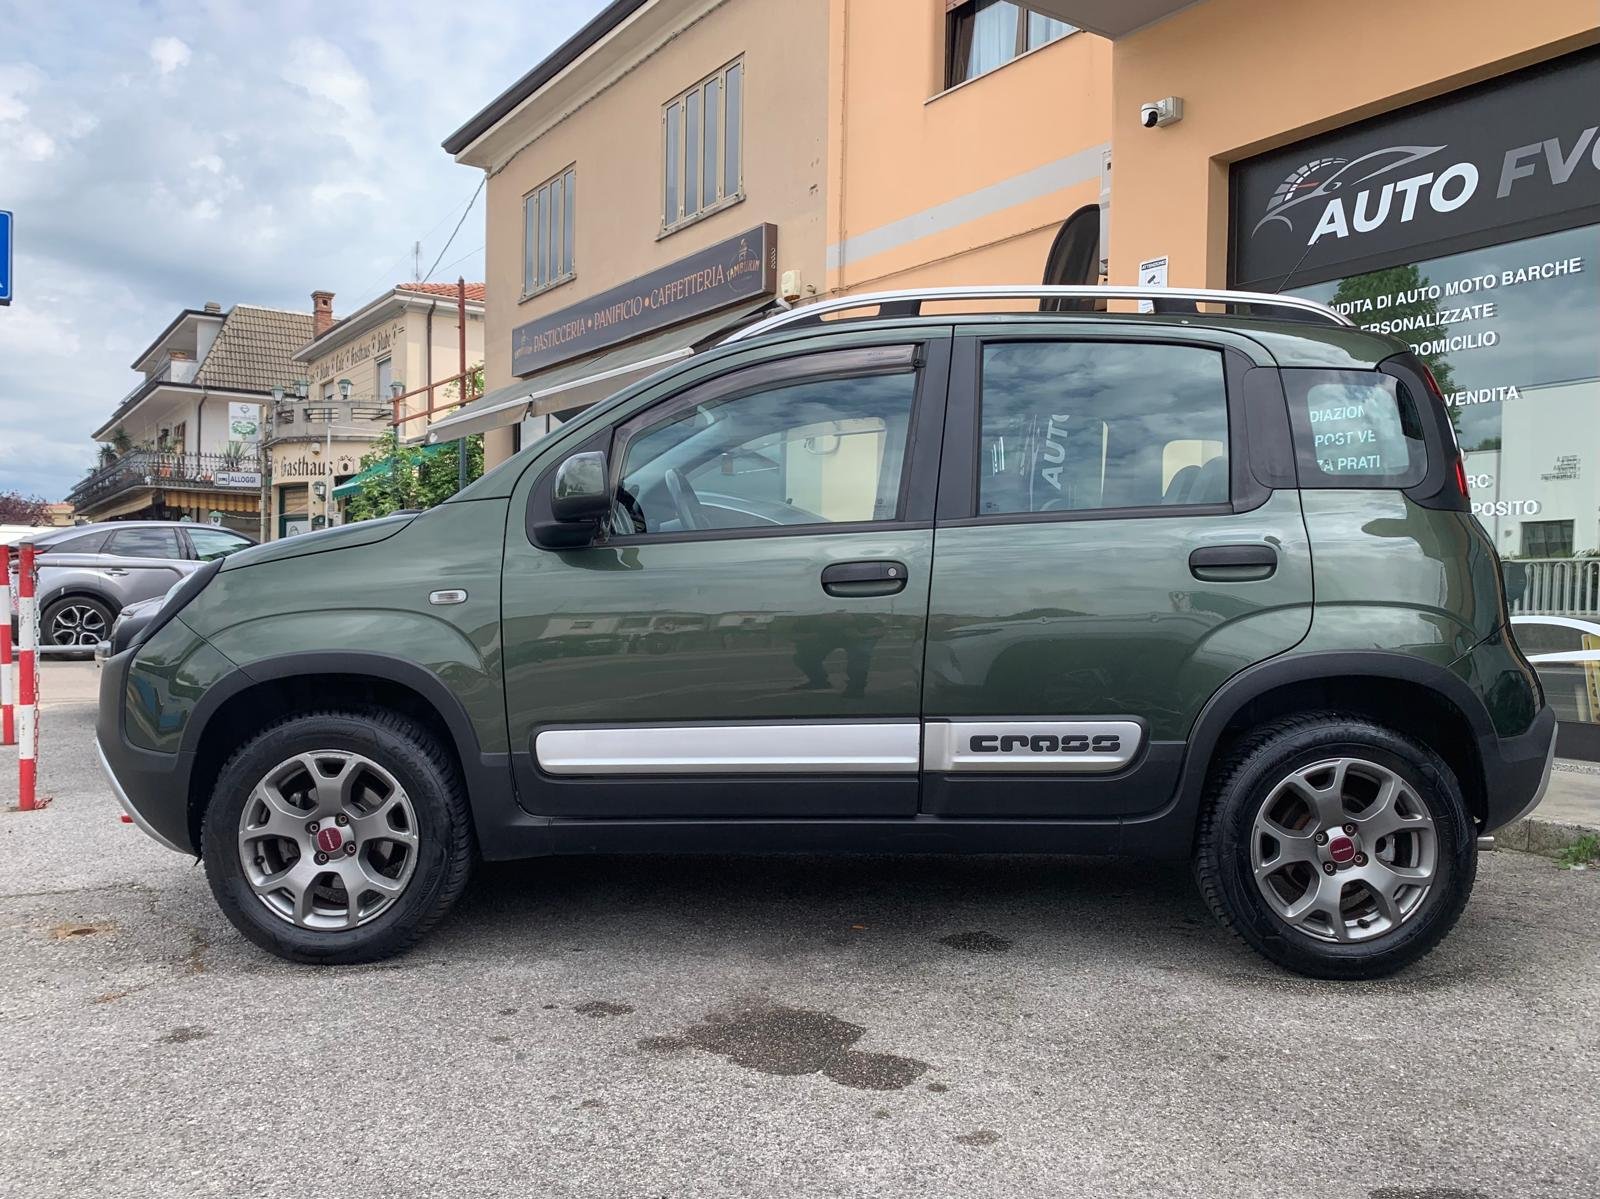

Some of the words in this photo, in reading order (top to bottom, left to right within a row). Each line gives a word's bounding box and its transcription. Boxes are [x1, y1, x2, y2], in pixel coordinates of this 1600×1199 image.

[1307, 161, 1479, 246] AUTO
[1496, 126, 1600, 199] FV
[1377, 294, 1392, 309] DI
[1396, 285, 1440, 306] AUTO
[1446, 275, 1496, 297] MOTO
[1502, 257, 1582, 286] BARCHE
[533, 317, 586, 354] PASTICCERIA
[593, 296, 643, 330] PANIFICIO
[650, 265, 725, 309] CAFFETTERIA
[1444, 385, 1519, 408] VENDITA
[1315, 431, 1353, 447] POST
[281, 455, 334, 477] Gasthaus
[1338, 455, 1380, 470] PRATI
[230, 476, 256, 484] ALLOGGI
[1471, 499, 1538, 516] POSITO
